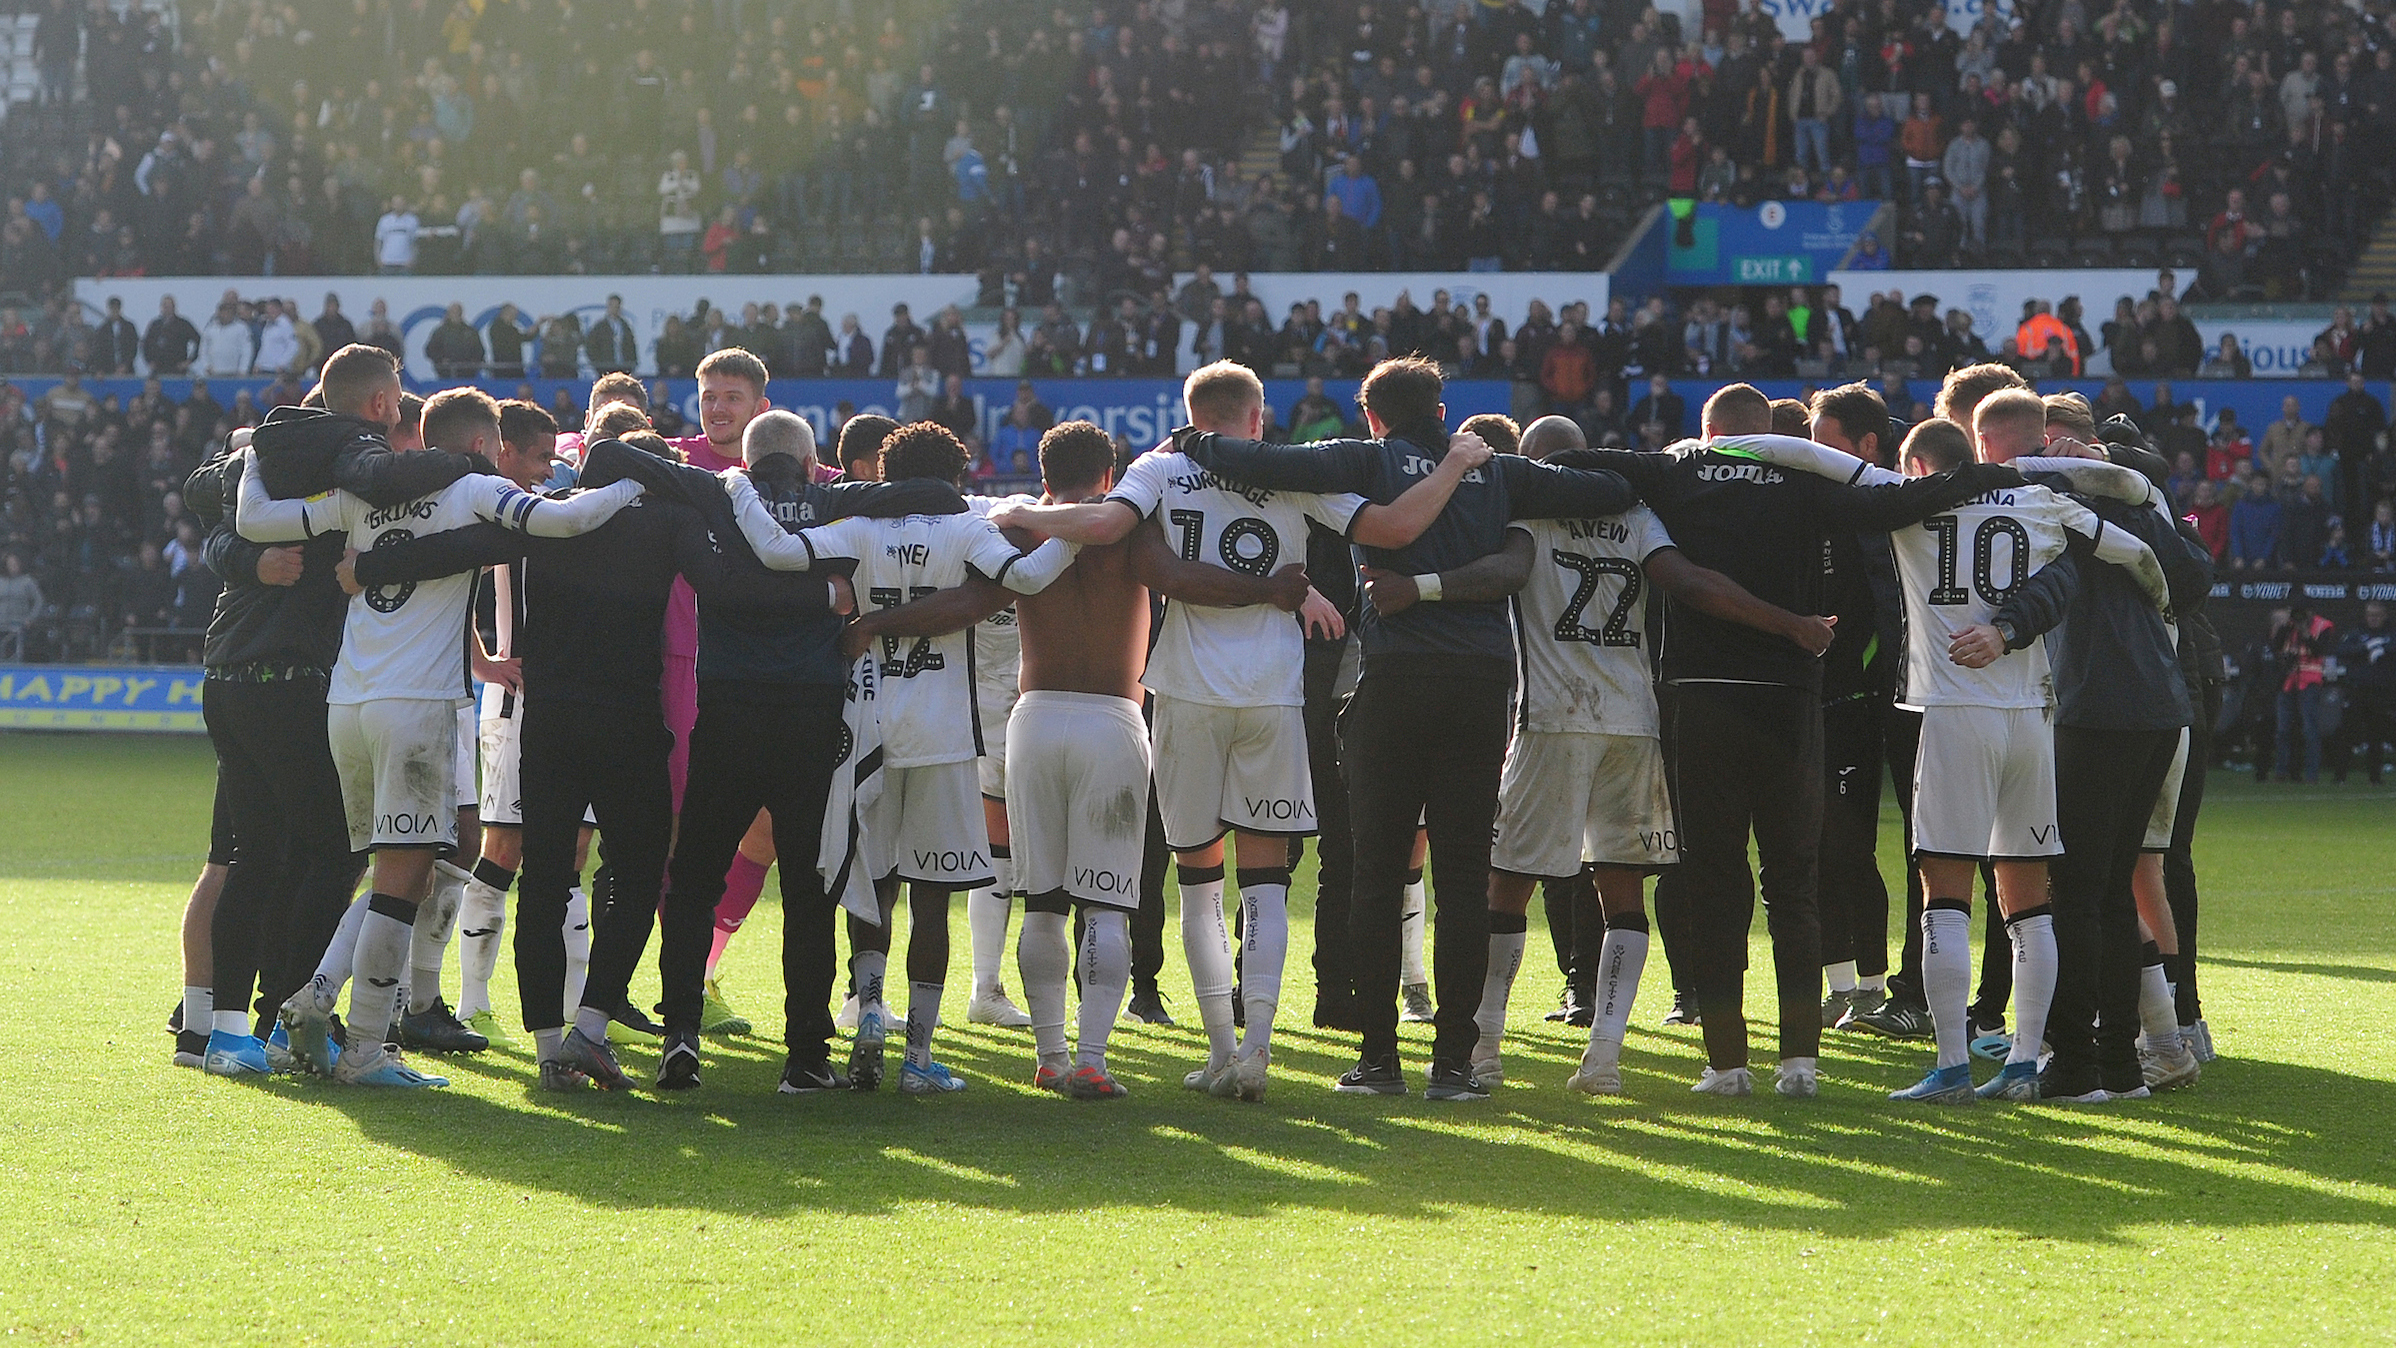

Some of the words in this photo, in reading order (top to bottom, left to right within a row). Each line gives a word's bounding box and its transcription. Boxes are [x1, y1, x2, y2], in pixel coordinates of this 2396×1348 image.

[1740, 258, 1781, 280] EXIT
[1170, 508, 1280, 579] 19
[1922, 515, 2030, 606] 10
[1552, 548, 1641, 649] 22
[1839, 780, 1847, 795] 6
